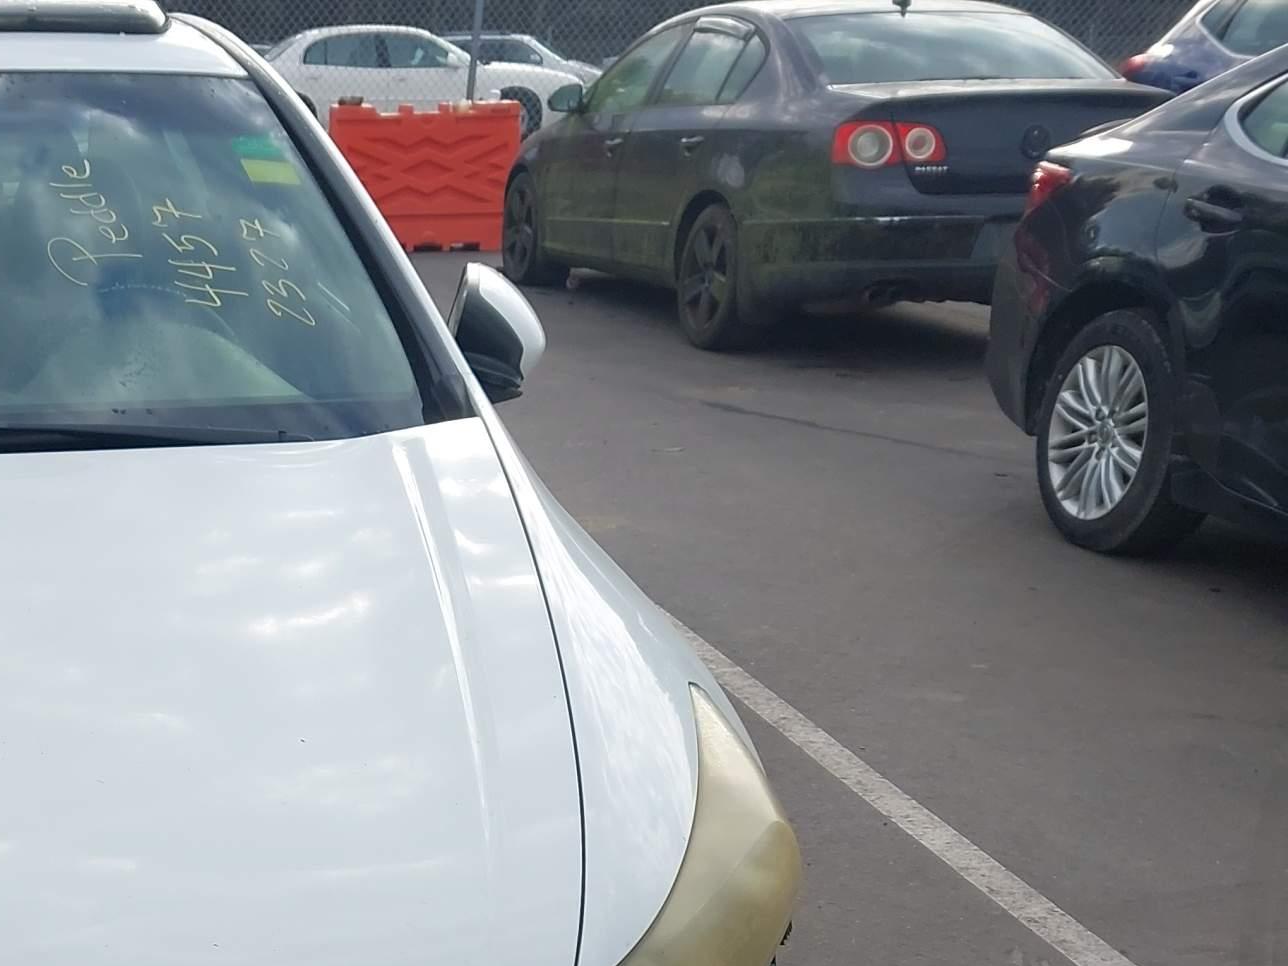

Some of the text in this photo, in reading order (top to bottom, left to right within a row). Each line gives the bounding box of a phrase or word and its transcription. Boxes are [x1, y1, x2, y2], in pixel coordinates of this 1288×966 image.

[46, 158, 143, 286] Peddle
[152, 197, 249, 308] 4457
[239, 218, 317, 327] 2327
